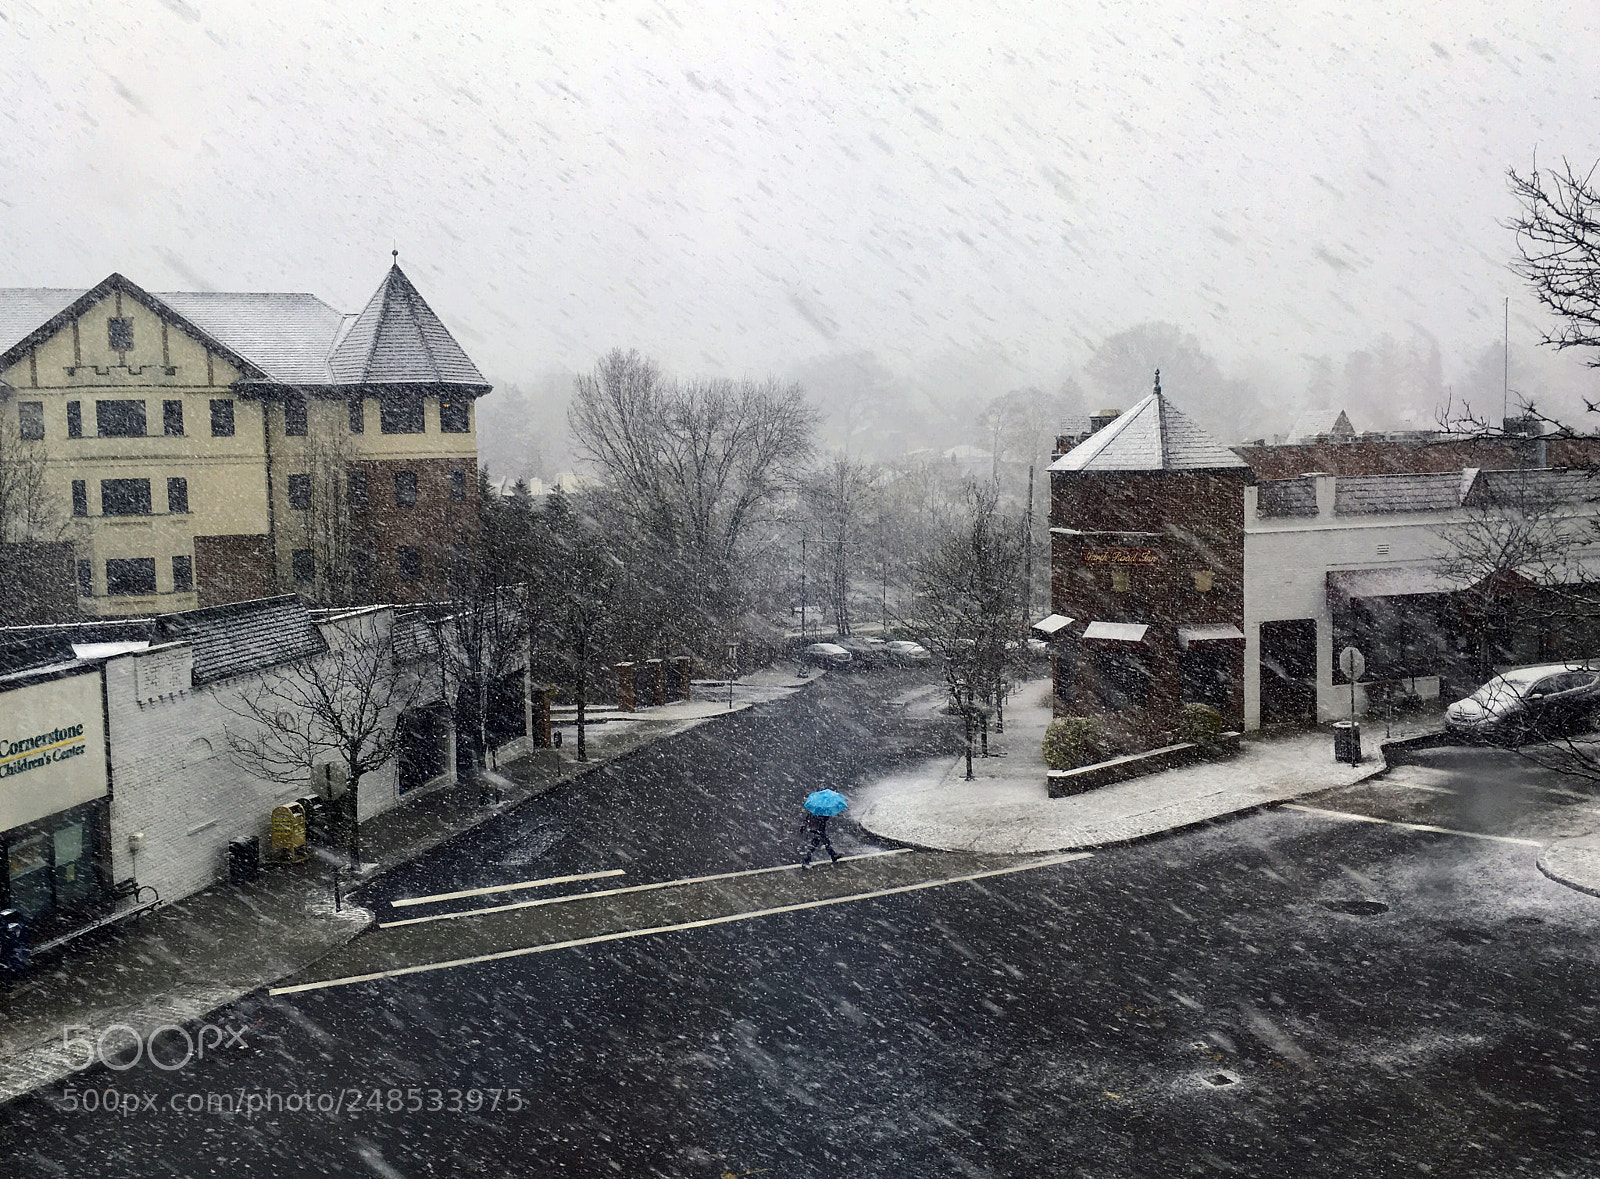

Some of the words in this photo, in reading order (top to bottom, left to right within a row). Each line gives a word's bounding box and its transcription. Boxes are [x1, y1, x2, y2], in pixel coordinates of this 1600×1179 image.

[0, 723, 84, 758] Cornerstone
[0, 751, 51, 778] Children's
[52, 744, 86, 762] Center
